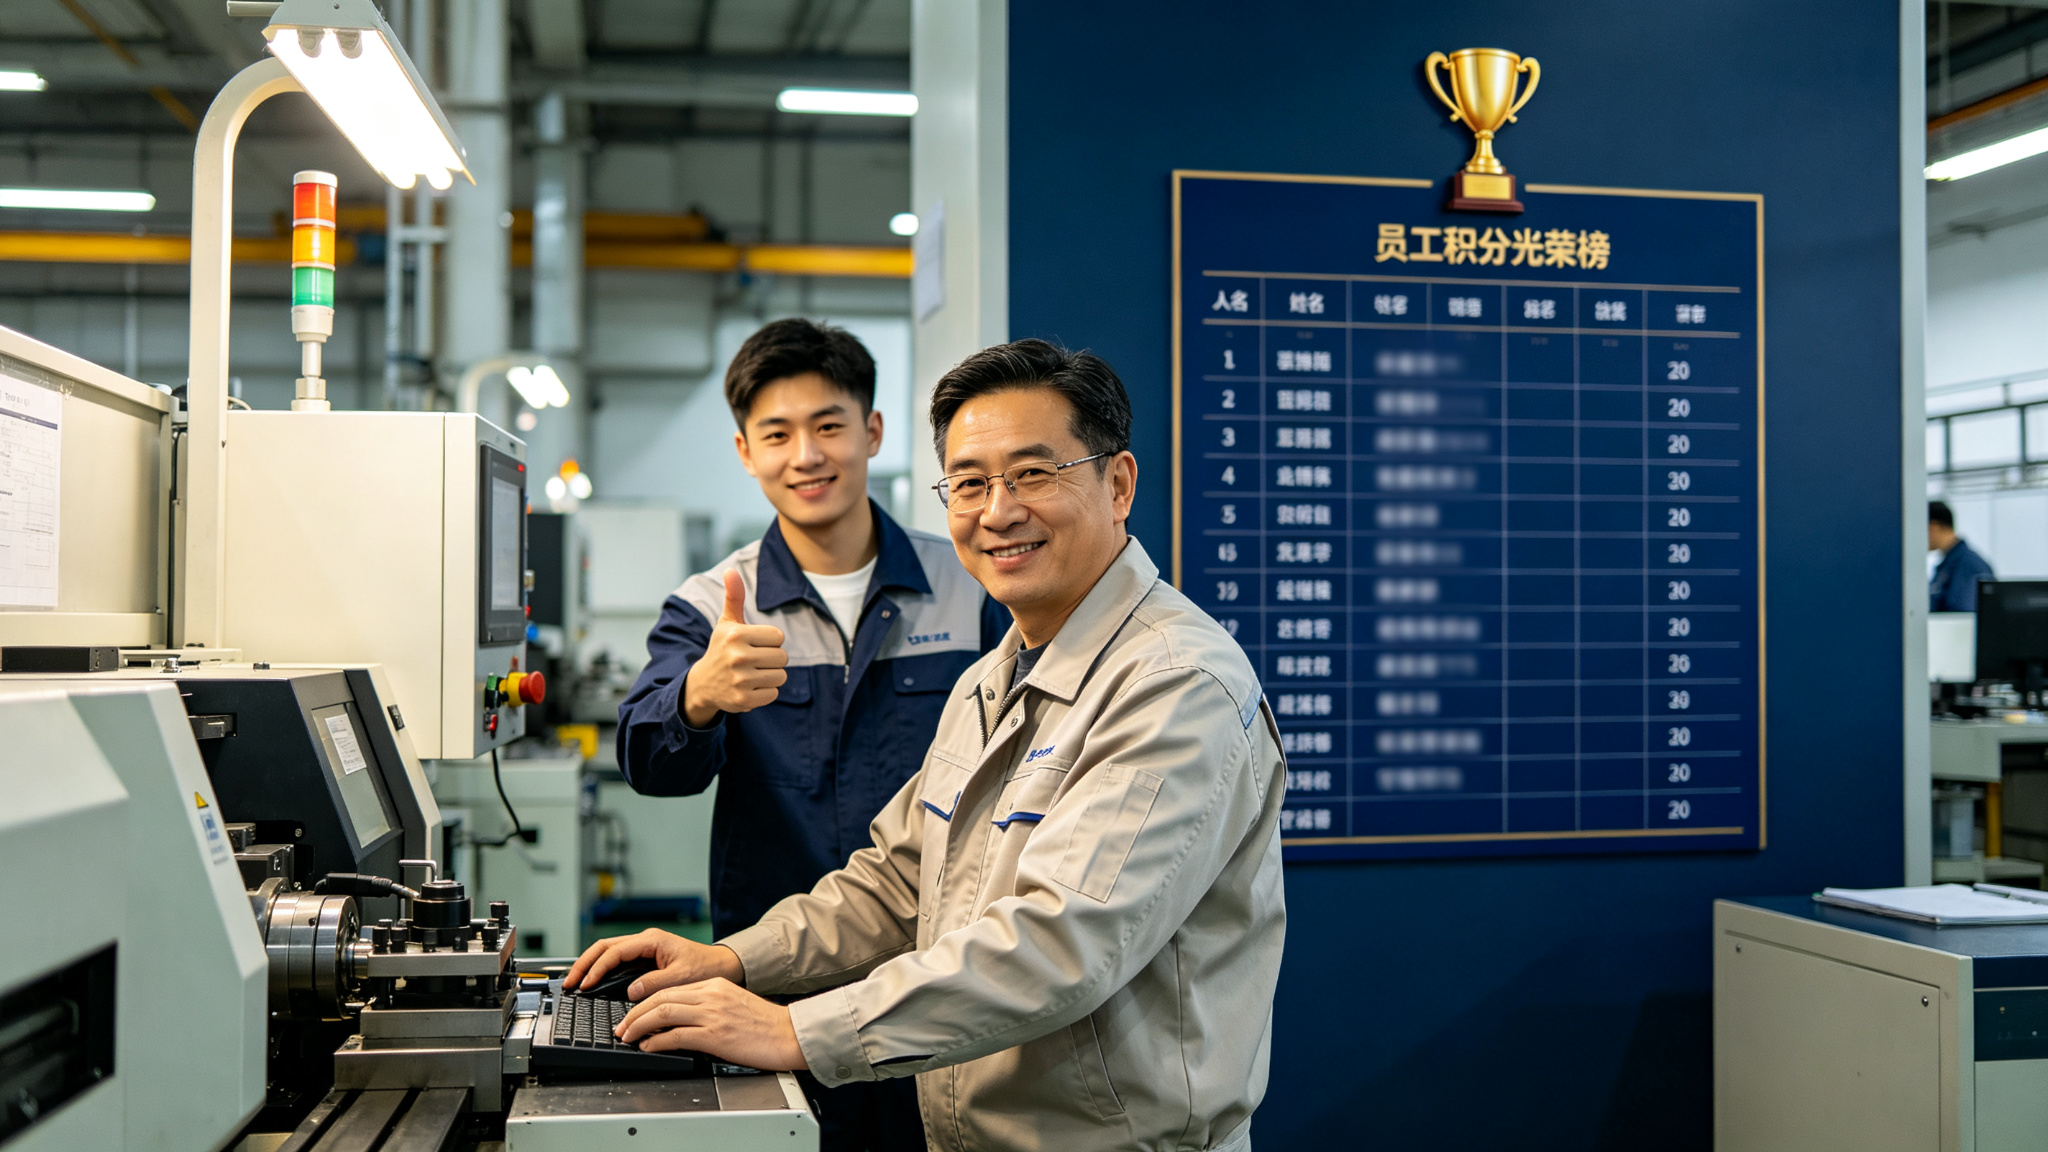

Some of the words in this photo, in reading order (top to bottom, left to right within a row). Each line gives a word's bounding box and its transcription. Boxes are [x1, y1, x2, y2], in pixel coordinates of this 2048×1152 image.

[1375, 223, 1611, 270] 员工积分光荣榜
[1212, 290, 1249, 312] 人名
[1223, 350, 1236, 370] 1
[1668, 361, 1690, 380] 20
[1221, 389, 1236, 409] 2
[1668, 398, 1690, 417] 20
[1221, 427, 1236, 447] 3
[1668, 434, 1690, 454] 20
[1221, 466, 1236, 485] 4
[1221, 504, 1237, 525] 5
[1668, 508, 1690, 527] 20
[1668, 544, 1690, 563] 20
[1669, 801, 1690, 819] 20
